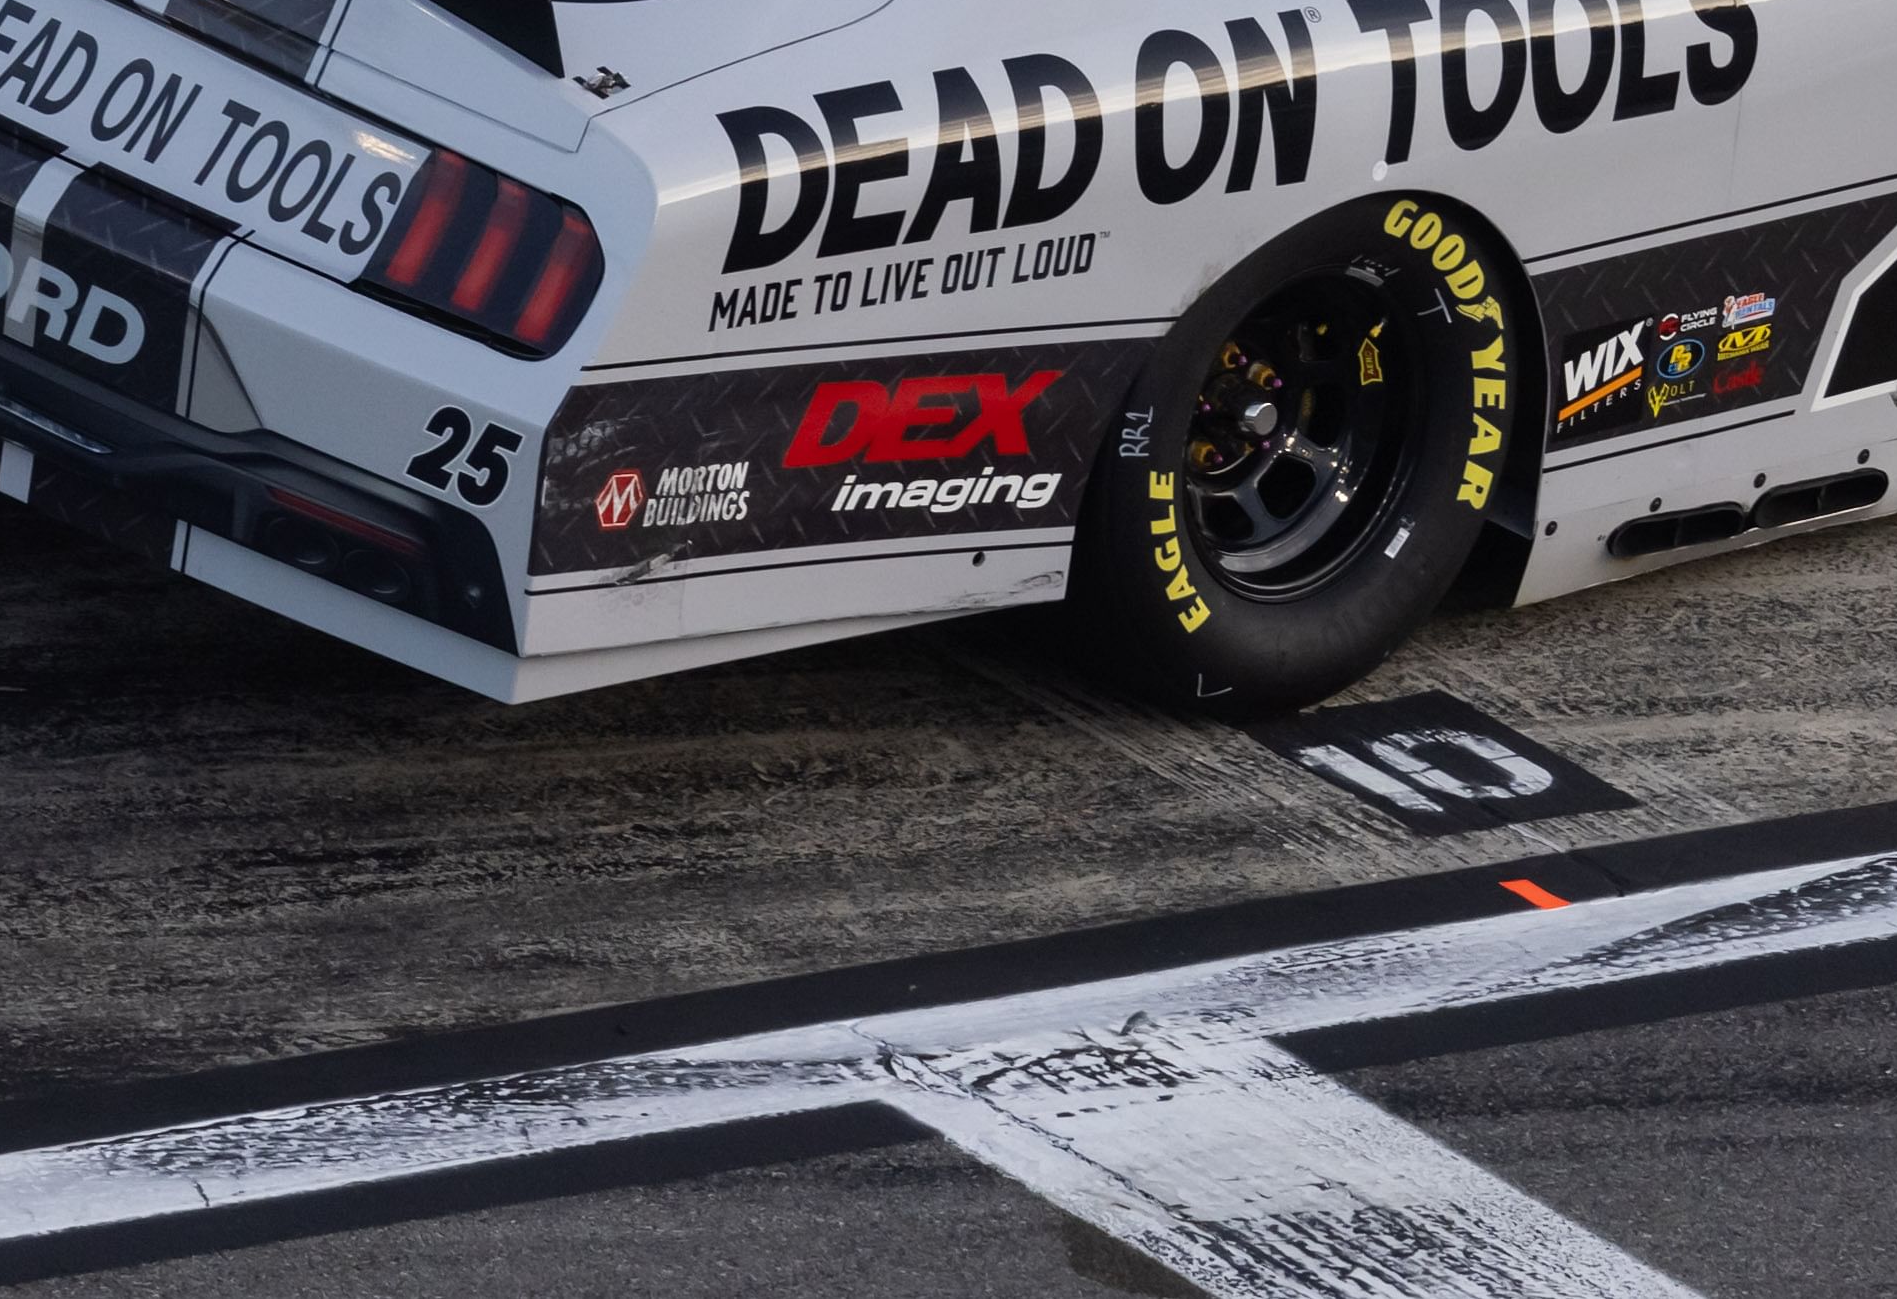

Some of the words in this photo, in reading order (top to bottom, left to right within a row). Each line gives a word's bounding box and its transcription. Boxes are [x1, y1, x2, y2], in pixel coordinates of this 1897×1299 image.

[91, 57, 201, 166] ON
[195, 98, 402, 256] TOOLS
[715, 53, 1102, 275] DEAD
[1135, 9, 1318, 205] ON
[708, 278, 803, 332] MADE
[814, 271, 856, 313] TO
[859, 257, 928, 309] LIVE
[941, 247, 1006, 295] OUT
[1012, 233, 1096, 284] LOUD
[1680, 316, 1716, 333] CIRCLE
[1681, 306, 1718, 323] FLYING
[1383, 200, 1506, 511] GOODYEAR
[1564, 320, 1646, 402] WIX
[782, 370, 1063, 468] DEX
[1557, 378, 1642, 434] FILTERS
[405, 405, 524, 507] 25
[659, 461, 749, 496] MORTON
[831, 467, 1062, 515] imaging
[642, 489, 749, 528] BUILDINGS
[1148, 471, 1211, 633] EAGLE
